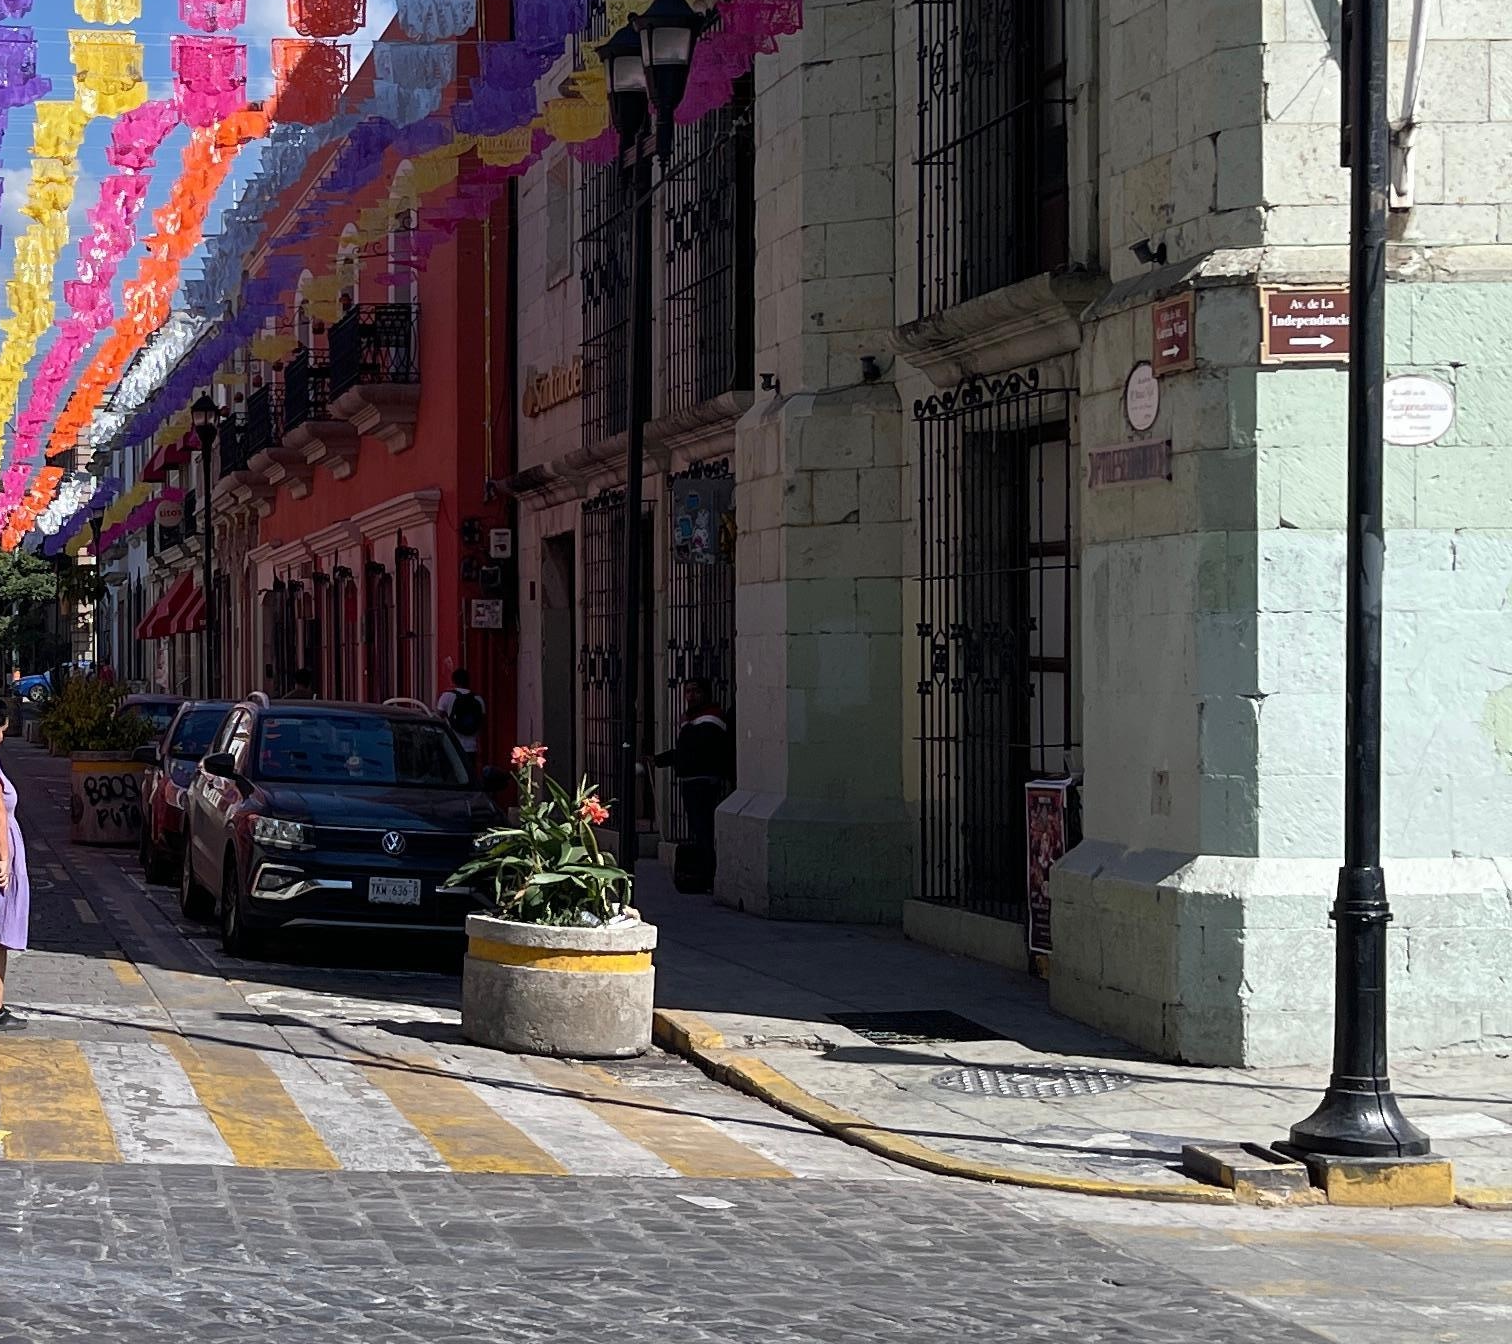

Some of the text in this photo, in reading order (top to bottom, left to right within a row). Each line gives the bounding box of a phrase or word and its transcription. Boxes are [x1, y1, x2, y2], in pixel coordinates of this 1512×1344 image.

[1290, 298, 1335, 310] Av. de La
